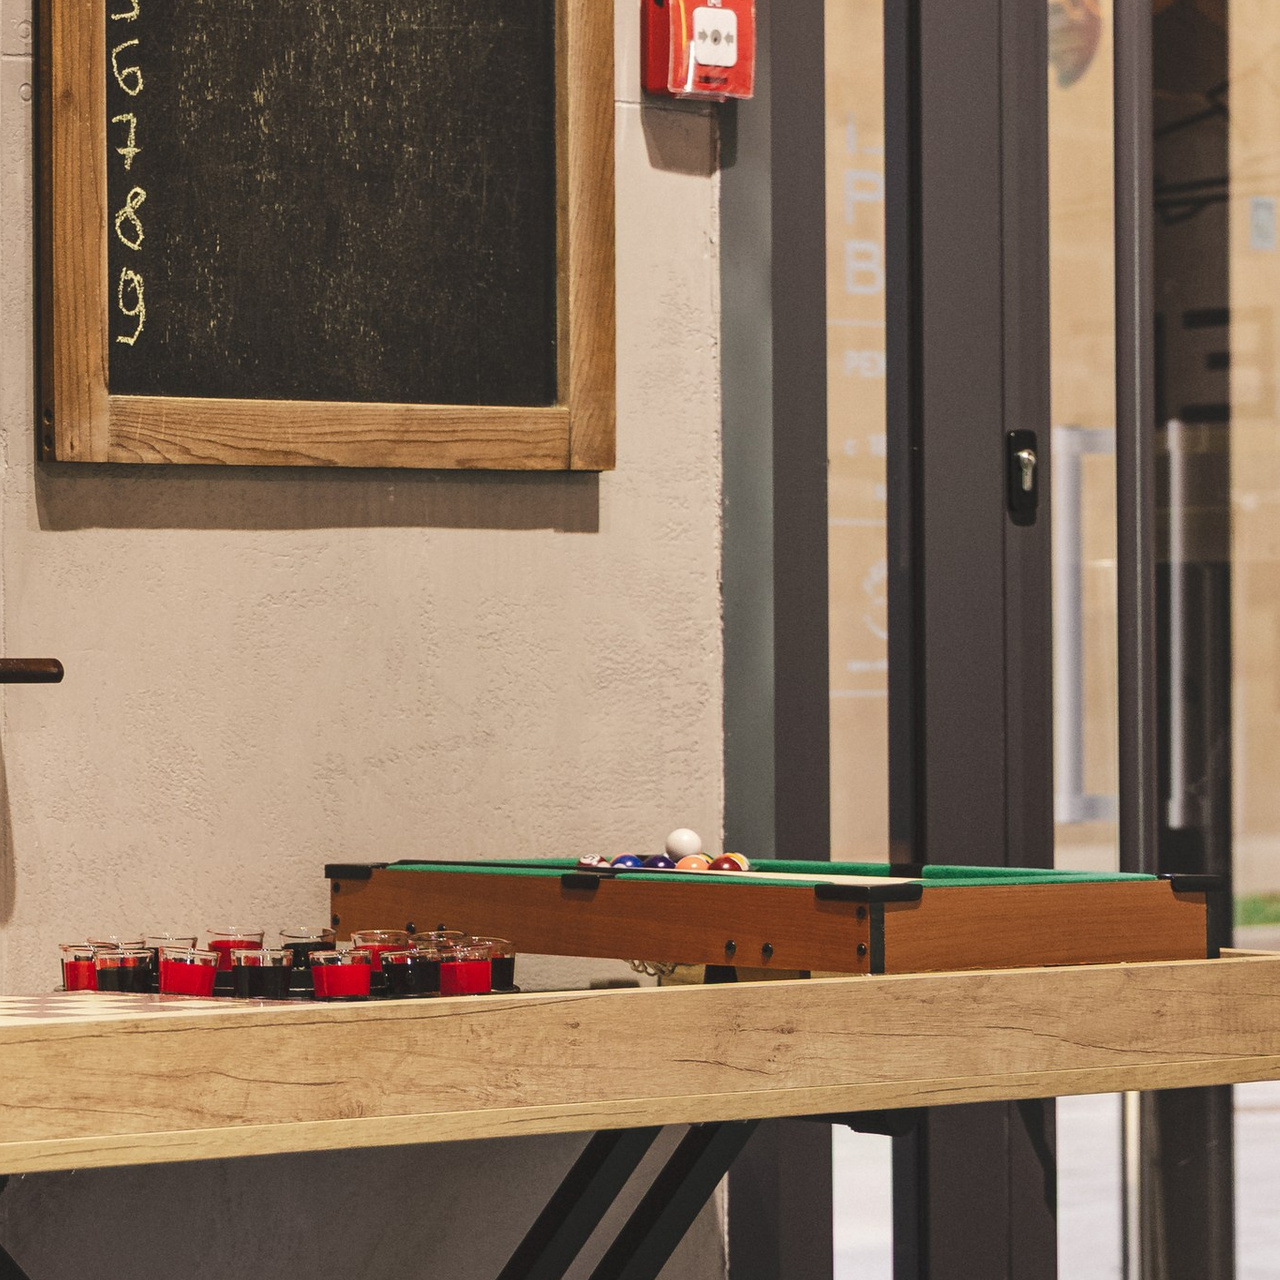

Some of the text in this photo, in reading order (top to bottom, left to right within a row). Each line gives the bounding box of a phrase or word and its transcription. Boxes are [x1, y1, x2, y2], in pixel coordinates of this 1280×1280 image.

[111, 38, 145, 97] 6
[112, 112, 143, 170] 7
[115, 185, 148, 251] 8
[116, 266, 147, 347] 9
